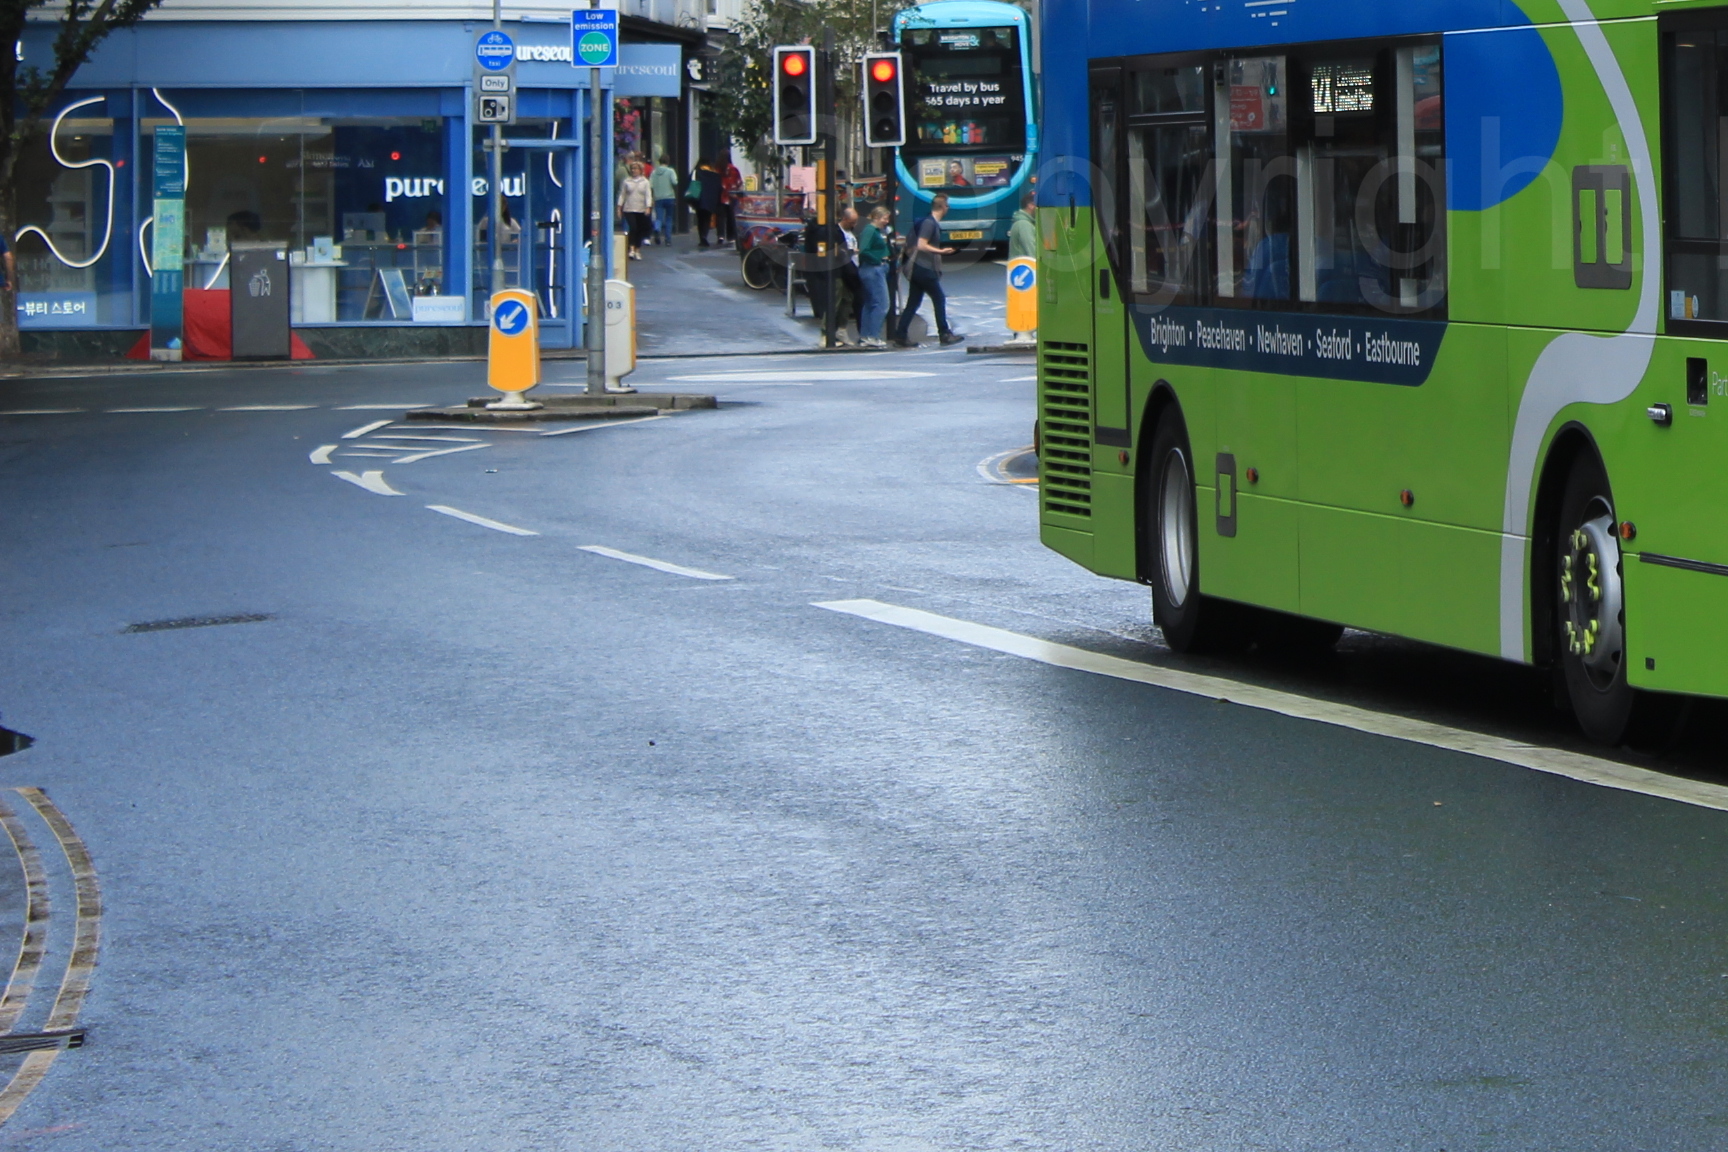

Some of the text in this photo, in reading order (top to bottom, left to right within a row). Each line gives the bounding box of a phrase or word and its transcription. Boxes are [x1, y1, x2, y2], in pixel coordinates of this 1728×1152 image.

[585, 12, 605, 20] Low
[574, 22, 615, 30] emission
[516, 45, 573, 62] ureseou
[580, 44, 610, 53] ZONE
[614, 63, 678, 76] ureseoul
[485, 79, 506, 89] Only
[929, 82, 1000, 94] Travel by bus
[945, 95, 971, 108] days
[973, 97, 980, 105] a
[981, 96, 1006, 107] year
[385, 172, 527, 203] pureul
[51, 300, 86, 315] 스토어
[1150, 315, 1421, 367] Brighton Peacehaven Newhaven Seaford Eastbourne
[1711, 371, 1728, 397] Part
